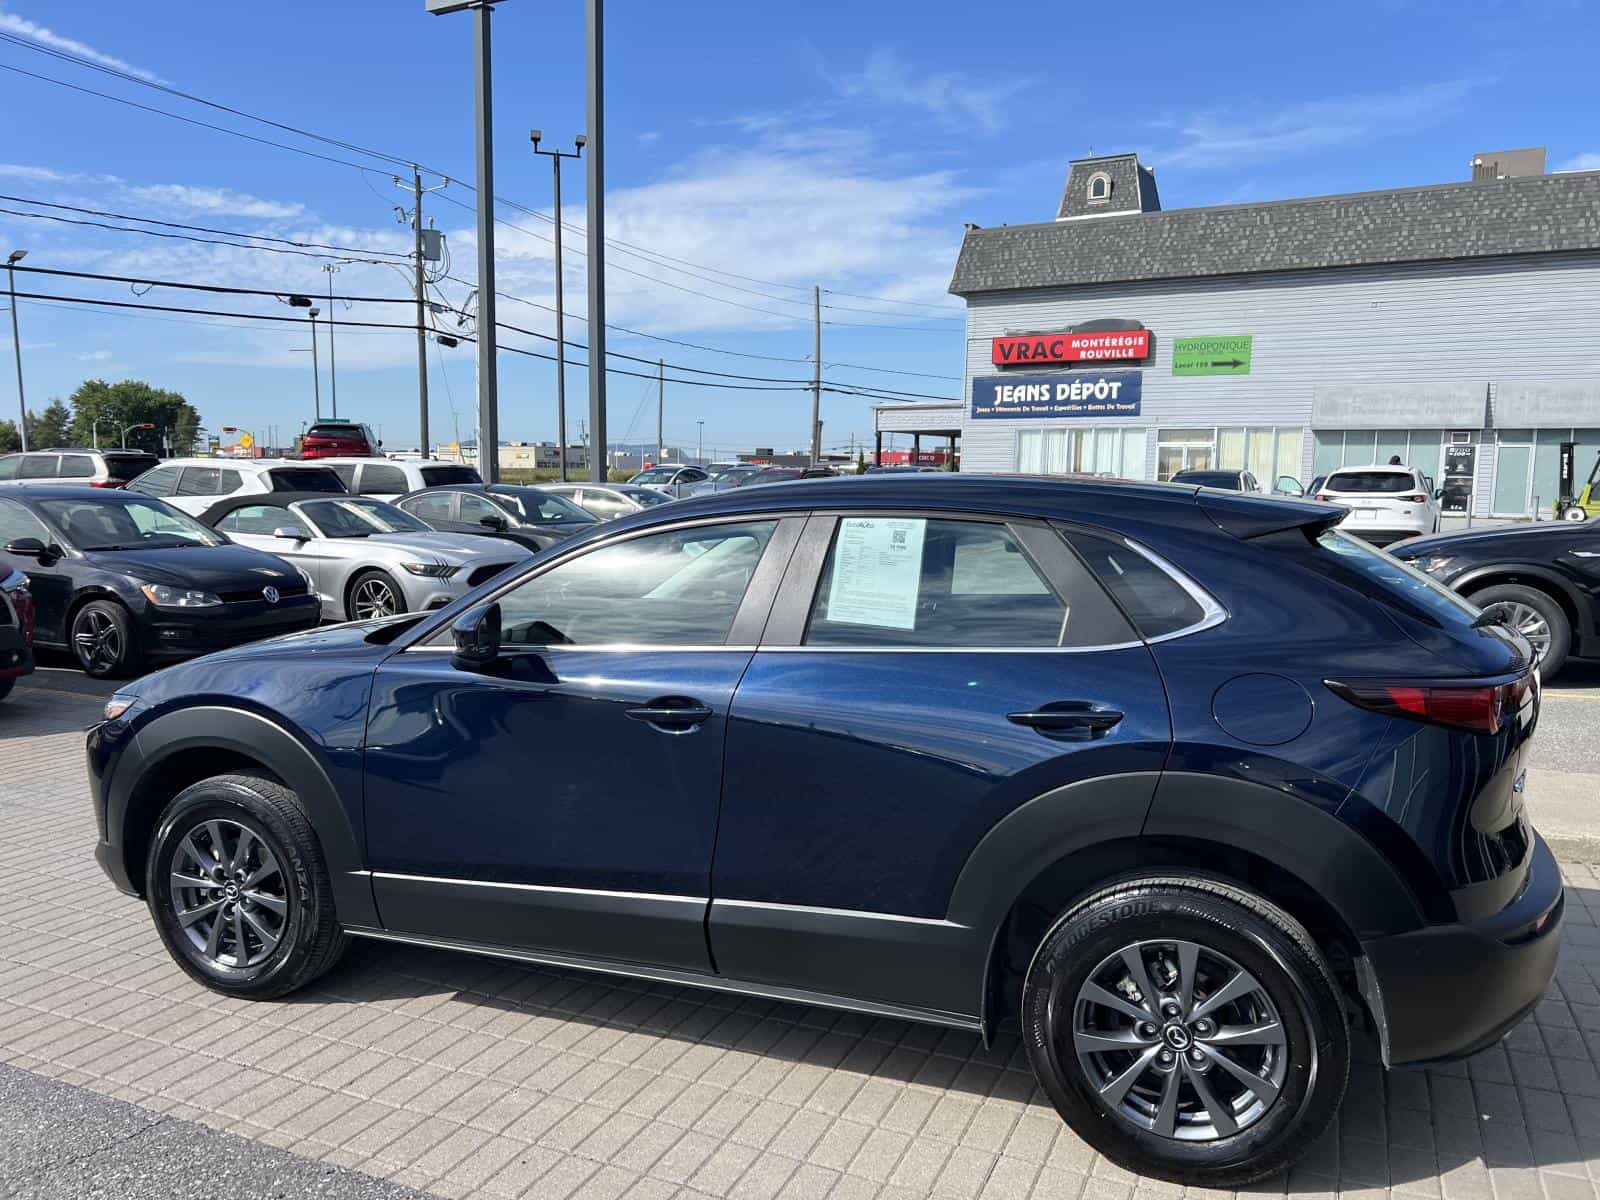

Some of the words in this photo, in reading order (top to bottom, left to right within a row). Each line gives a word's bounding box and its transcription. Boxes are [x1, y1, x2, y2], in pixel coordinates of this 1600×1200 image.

[998, 340, 1064, 361] VRAC
[1071, 335, 1145, 348] MONTÉRÉGIE
[1080, 348, 1134, 359] ROUVILLE
[1174, 341, 1249, 352] HYDROPONIQUE
[994, 383, 1050, 405] JEANS
[1056, 379, 1122, 401] DÉPÔT
